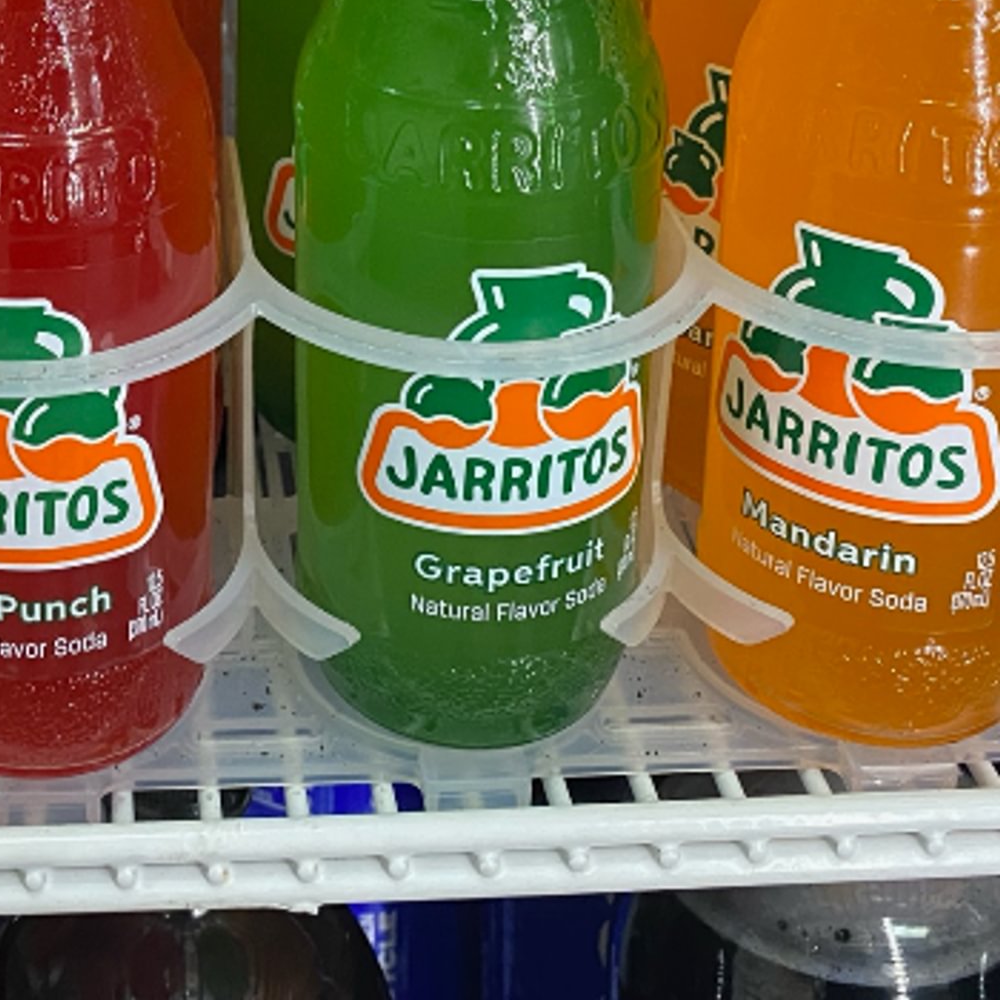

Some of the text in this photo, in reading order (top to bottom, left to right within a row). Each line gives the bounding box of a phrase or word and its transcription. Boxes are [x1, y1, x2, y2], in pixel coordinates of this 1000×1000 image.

[385, 425, 628, 503] JARRITOS
[726, 377, 968, 490] JARRITOS
[413, 536, 605, 593] Grapefruit
[731, 527, 928, 613] Natural Flavor Soda
[741, 487, 918, 576] Mandarin
[410, 575, 607, 622] Natural Flavor Soda
[53, 630, 109, 657] Soda
